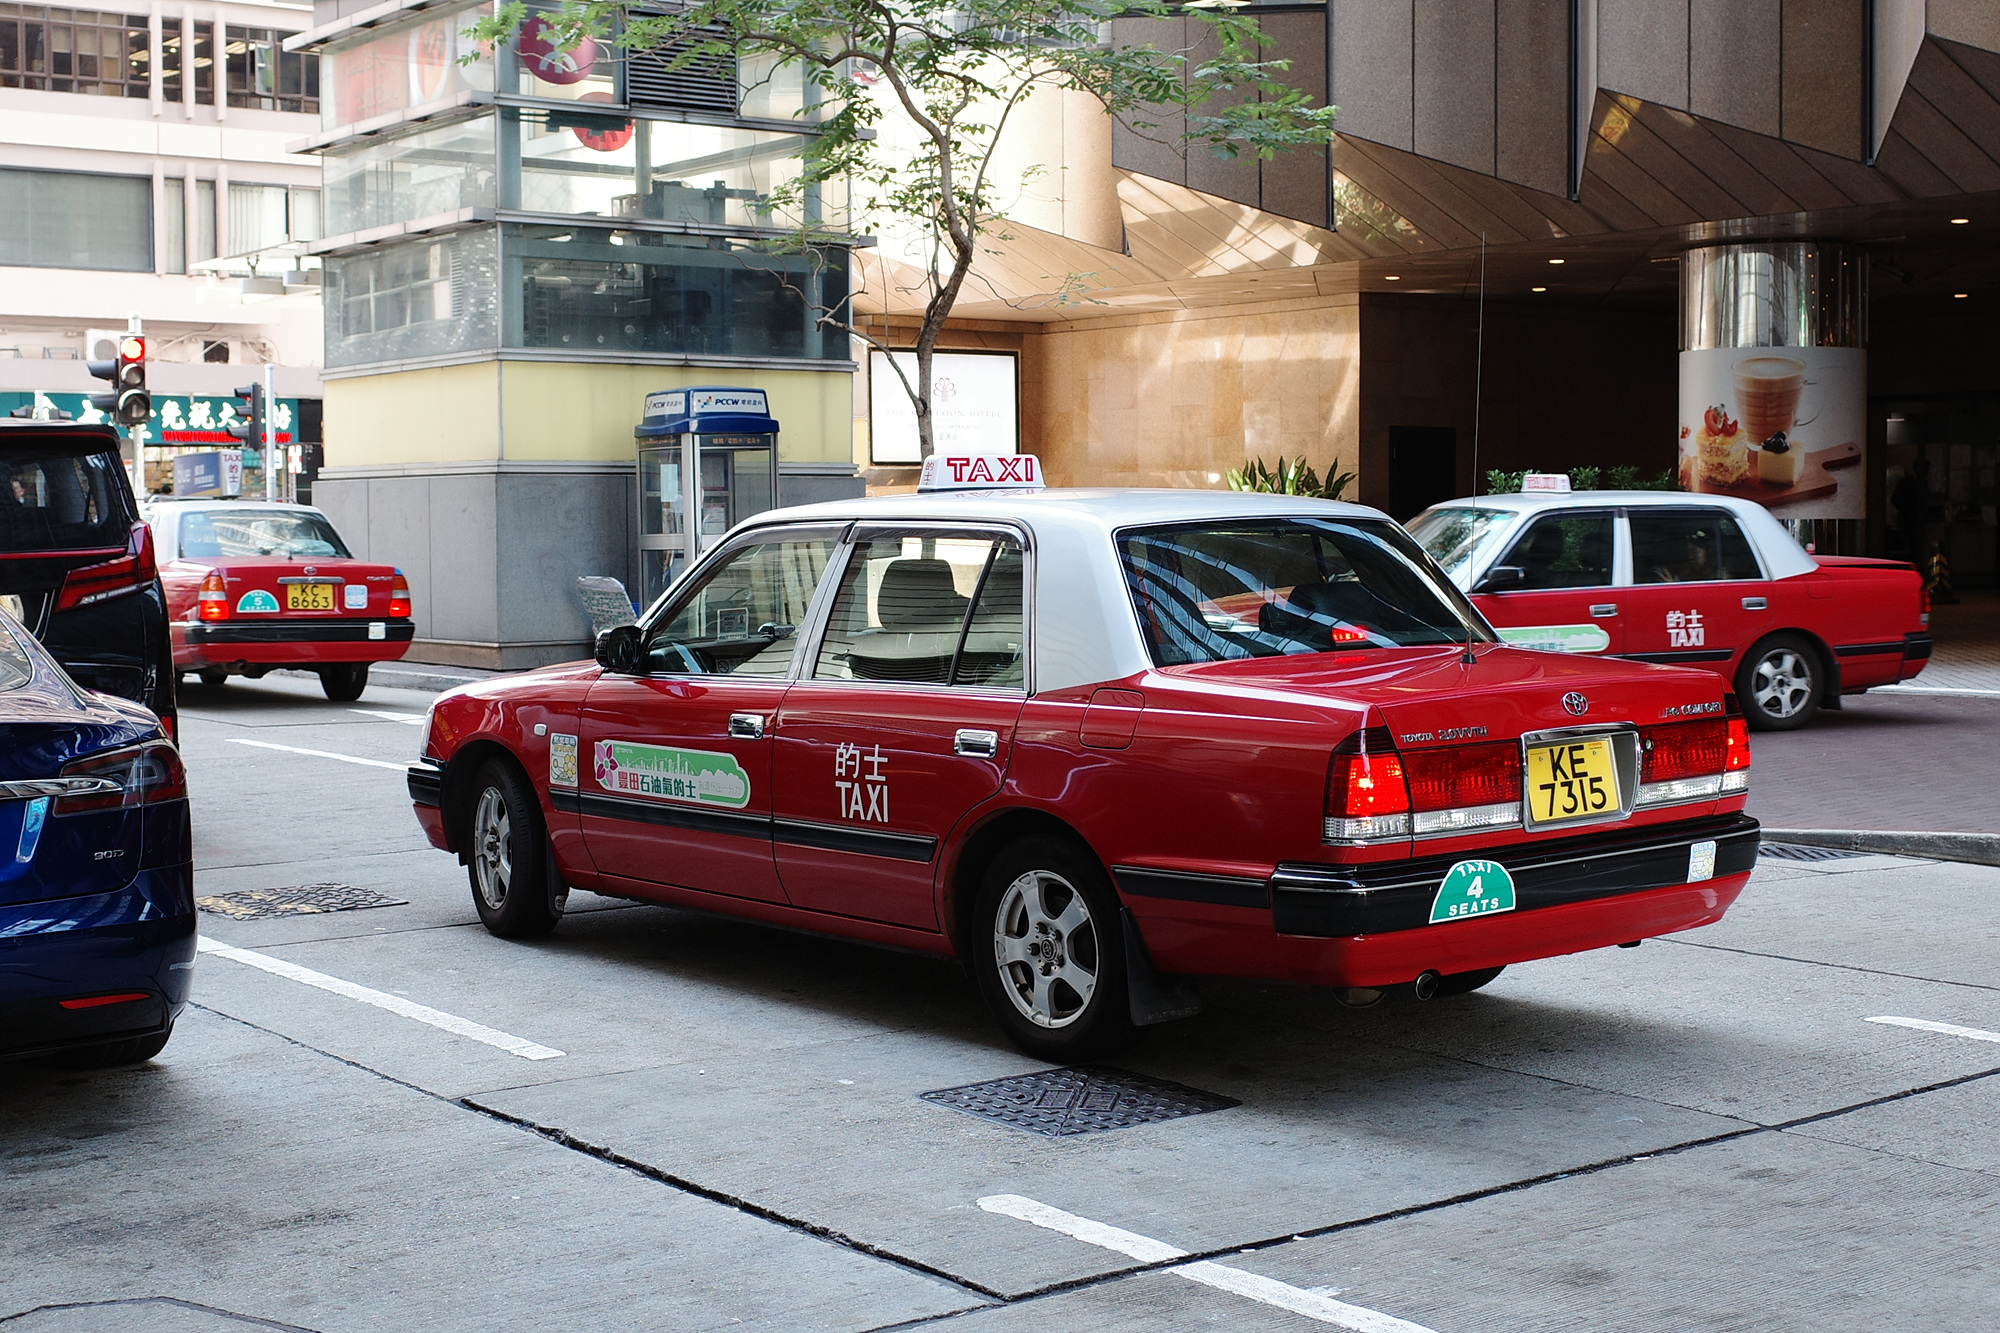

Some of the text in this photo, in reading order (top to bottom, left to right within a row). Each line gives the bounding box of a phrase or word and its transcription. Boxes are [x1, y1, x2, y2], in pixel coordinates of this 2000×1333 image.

[652, 401, 666, 409] PCCW
[715, 398, 740, 406] PCCW
[911, 409, 964, 417] KLOON
[969, 410, 1003, 418] HOTEL
[228, 464, 239, 483] 的士
[924, 461, 935, 484] 的士
[946, 457, 1034, 483] TAXI
[1524, 476, 1557, 490] TAXI
[300, 585, 320, 596] KC
[253, 597, 263, 606] 5
[291, 596, 330, 608] 8663
[1666, 609, 1704, 628] 的士
[1667, 628, 1704, 648] TAXI
[1681, 701, 1722, 715] COMFORT
[1401, 732, 1435, 743] TOYOTA
[835, 742, 888, 782] 的士
[1549, 744, 1590, 781] KE
[618, 770, 697, 800] 豐田石油氣的士
[835, 781, 889, 823] TAXI
[1539, 776, 1608, 817] 7315
[1456, 861, 1492, 878] TAXI
[1466, 875, 1484, 899] 4
[1448, 896, 1499, 917] SEATS
